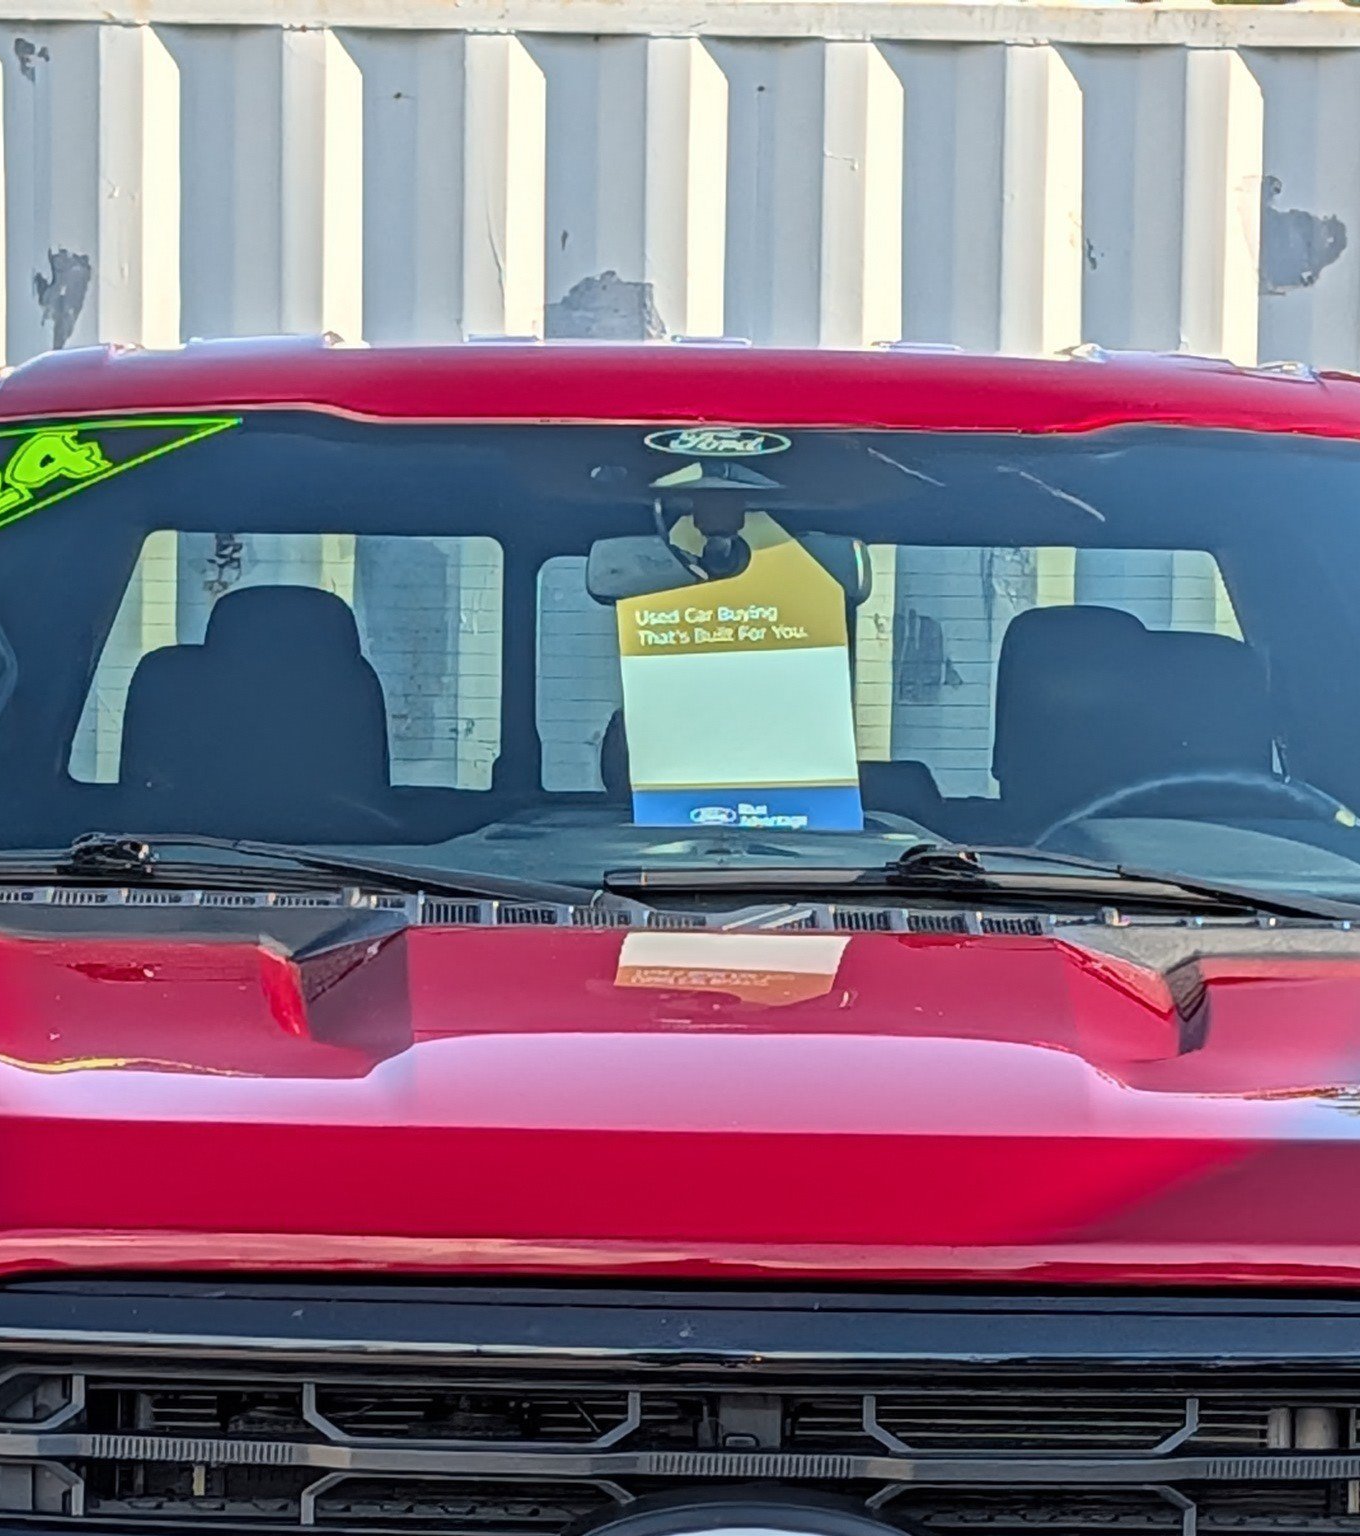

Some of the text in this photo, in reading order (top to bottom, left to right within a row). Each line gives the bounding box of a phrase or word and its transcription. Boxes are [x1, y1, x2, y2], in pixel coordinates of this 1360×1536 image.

[668, 430, 766, 452] Ford
[635, 605, 778, 626] Used Car Buying
[638, 630, 690, 646] That's
[693, 626, 735, 645] Built
[737, 624, 767, 642] For
